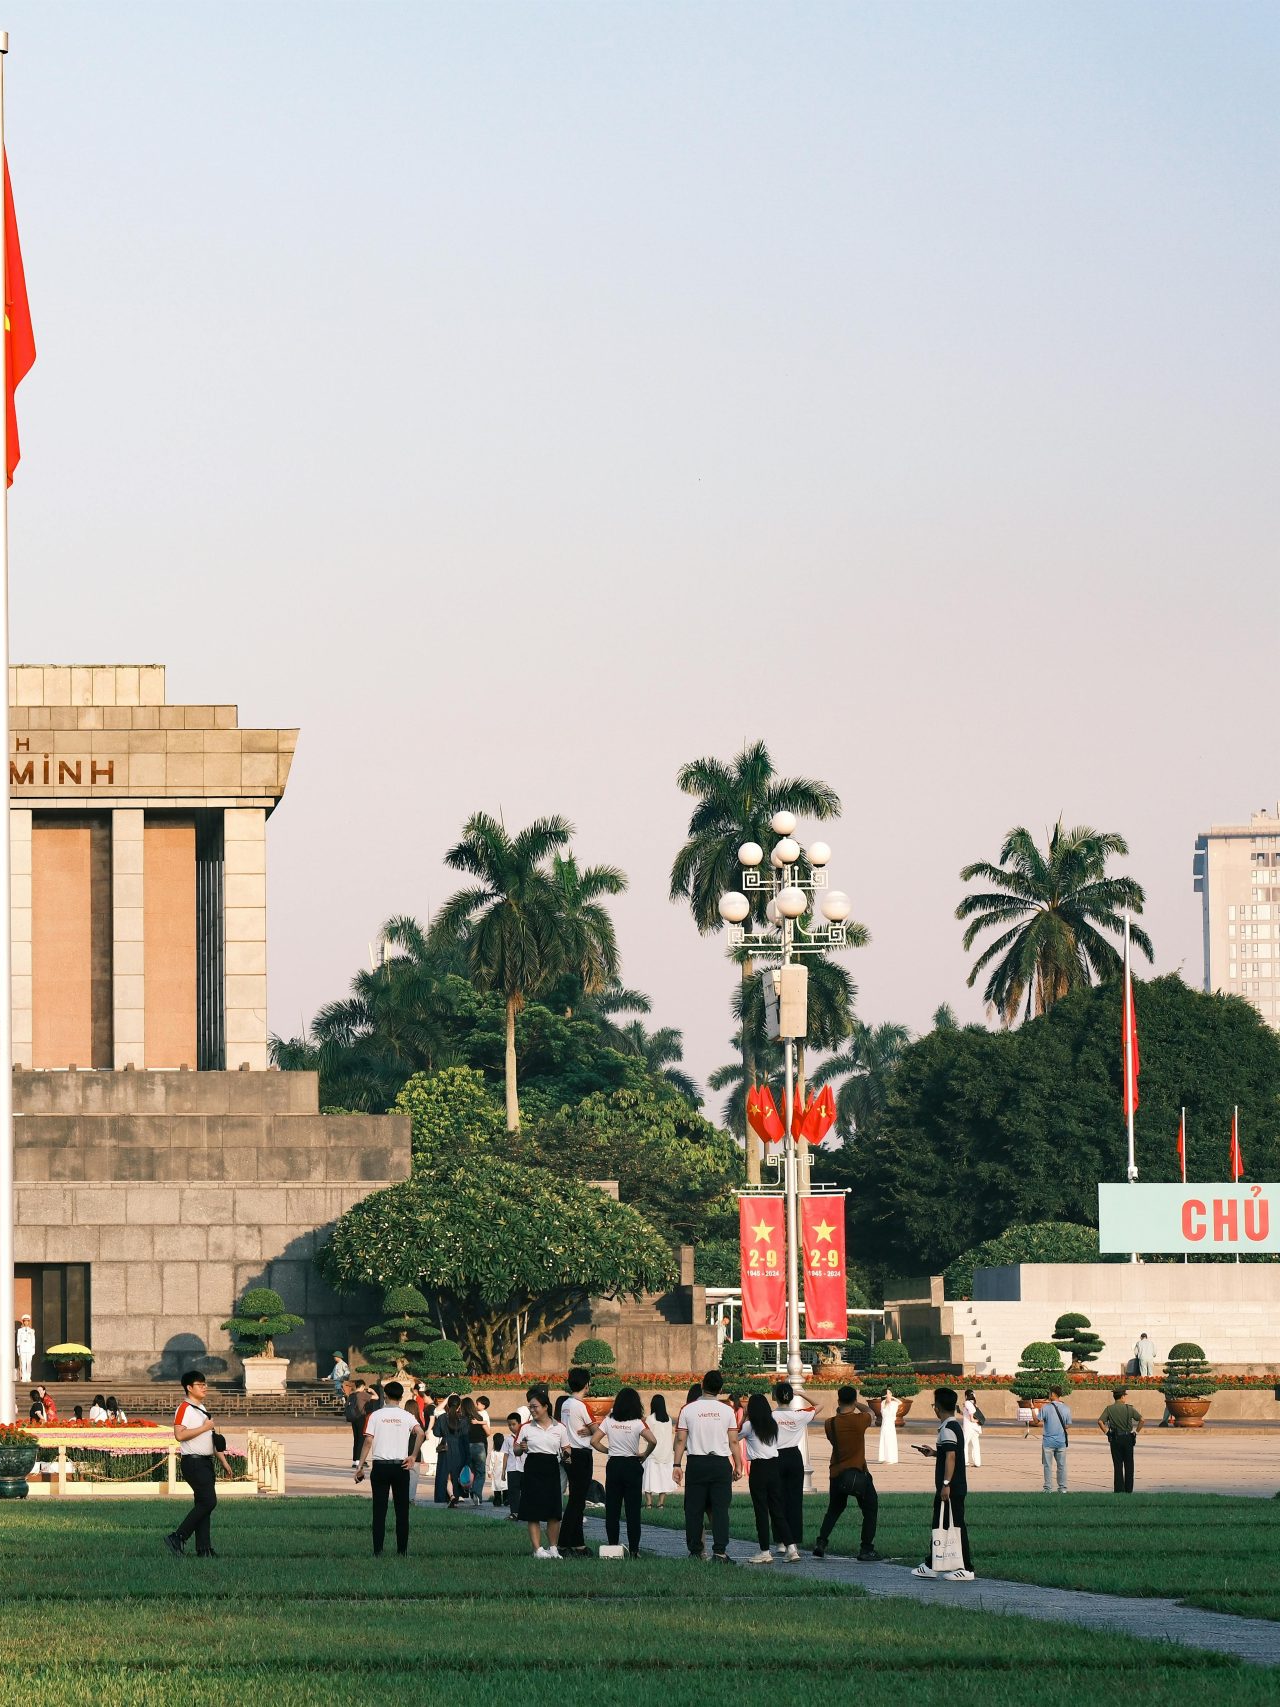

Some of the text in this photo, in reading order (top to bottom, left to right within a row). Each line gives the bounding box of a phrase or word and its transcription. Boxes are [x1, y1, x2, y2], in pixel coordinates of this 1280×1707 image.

[1181, 1185, 1270, 1242] CHỦ
[749, 1249, 777, 1268] 2-9
[810, 1249, 839, 1268] 2-9
